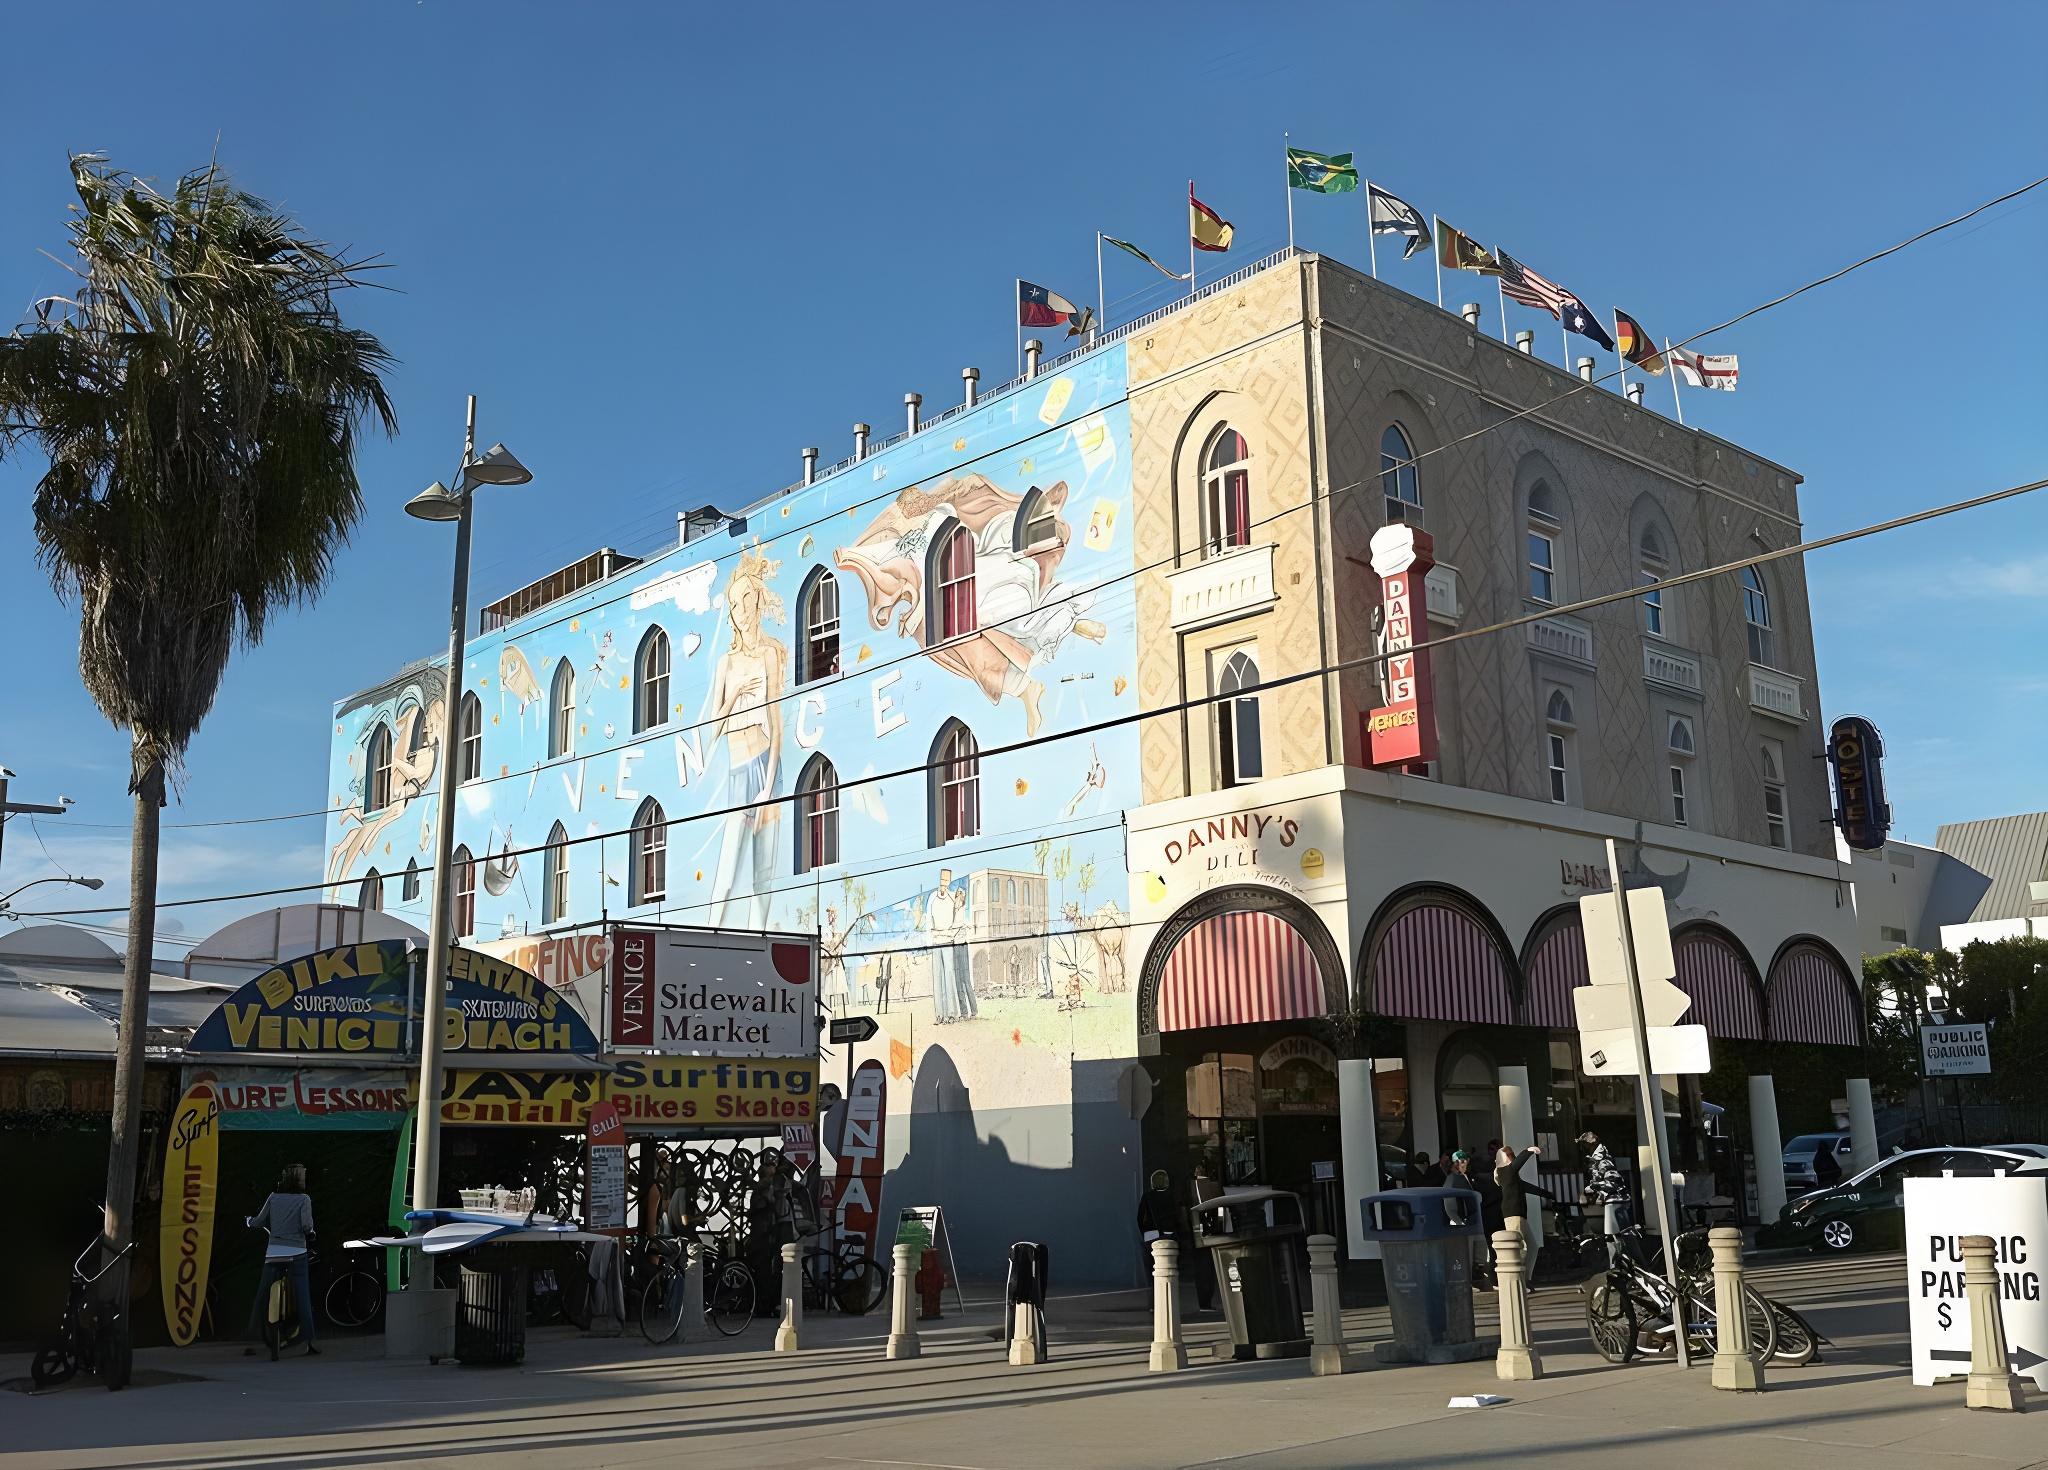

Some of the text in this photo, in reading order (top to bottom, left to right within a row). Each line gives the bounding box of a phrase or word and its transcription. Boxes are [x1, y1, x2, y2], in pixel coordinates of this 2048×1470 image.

[1164, 813, 1299, 864] DANNY'S
[256, 943, 561, 1020] BIKE ENTALS
[622, 938, 646, 1036] VENICE
[660, 983, 798, 1015] Sidewalk
[223, 1003, 571, 1051] VENICE BEACH
[661, 1015, 771, 1045] Market
[1929, 1031, 1984, 1044] PUBLIC
[293, 1070, 407, 1116] LESSONS
[441, 1071, 597, 1102] JAY'S
[614, 1060, 812, 1095] Surfing
[440, 1098, 592, 1124] entals
[612, 1094, 812, 1119] Bikes Skates
[173, 1101, 218, 1150] Surf
[176, 1142, 203, 1340] LESSONS
[1930, 1235, 2027, 1264] PUIC
